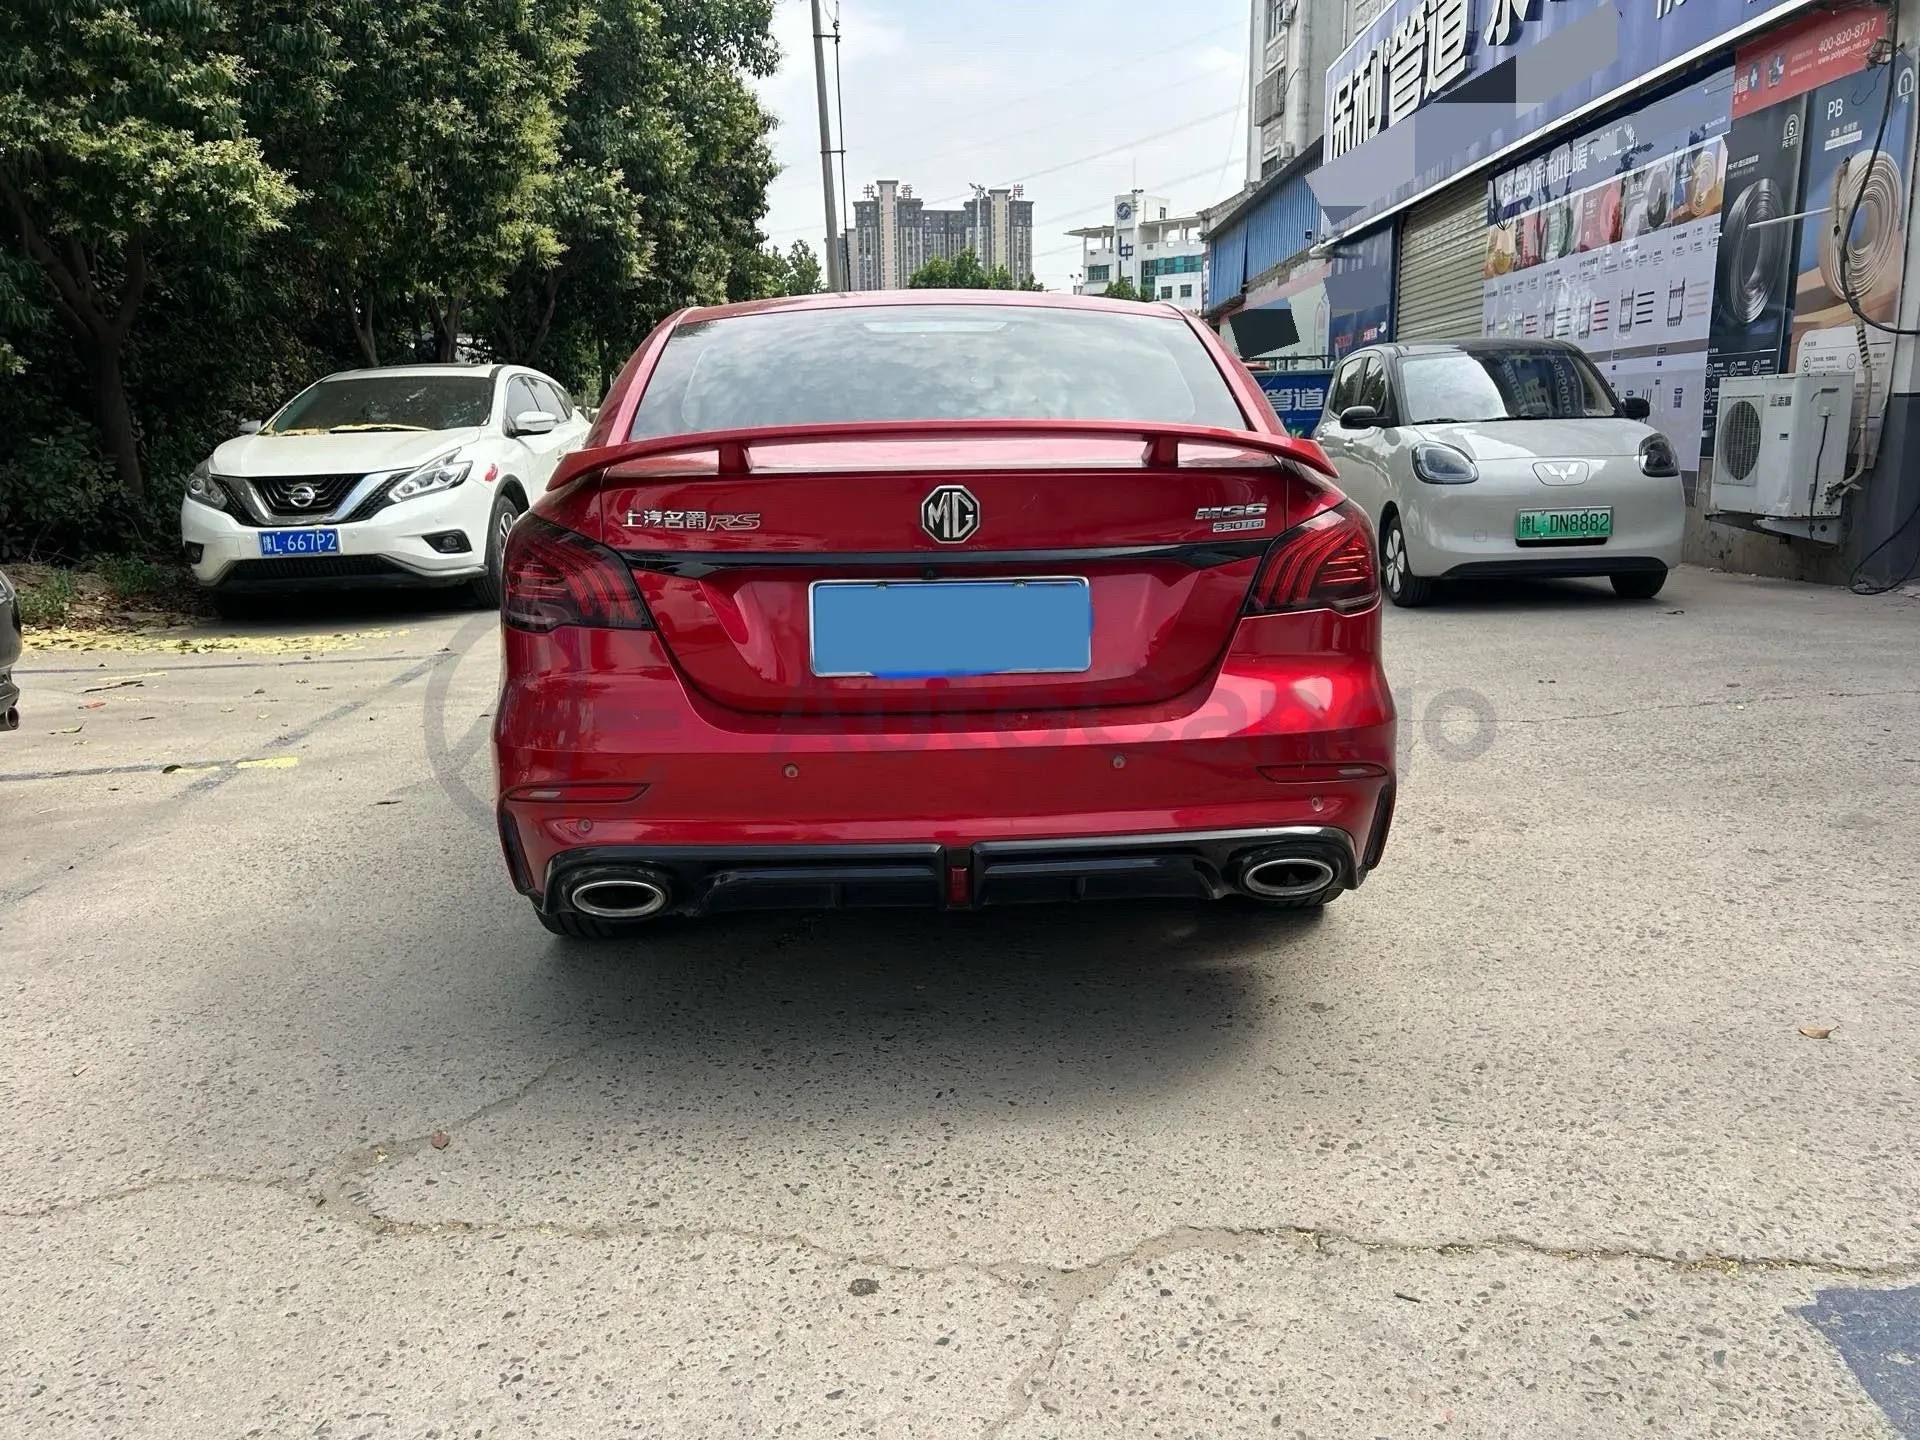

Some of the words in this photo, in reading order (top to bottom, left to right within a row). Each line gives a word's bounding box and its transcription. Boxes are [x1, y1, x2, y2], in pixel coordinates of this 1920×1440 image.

[1818, 17, 1877, 53] 400-820-8717
[1827, 98, 1844, 120] PB
[1265, 387, 1324, 412] 管道
[622, 509, 707, 529] 上汽名爵
[706, 513, 761, 532] RS
[927, 491, 974, 538] MG
[1195, 502, 1267, 520] MG6
